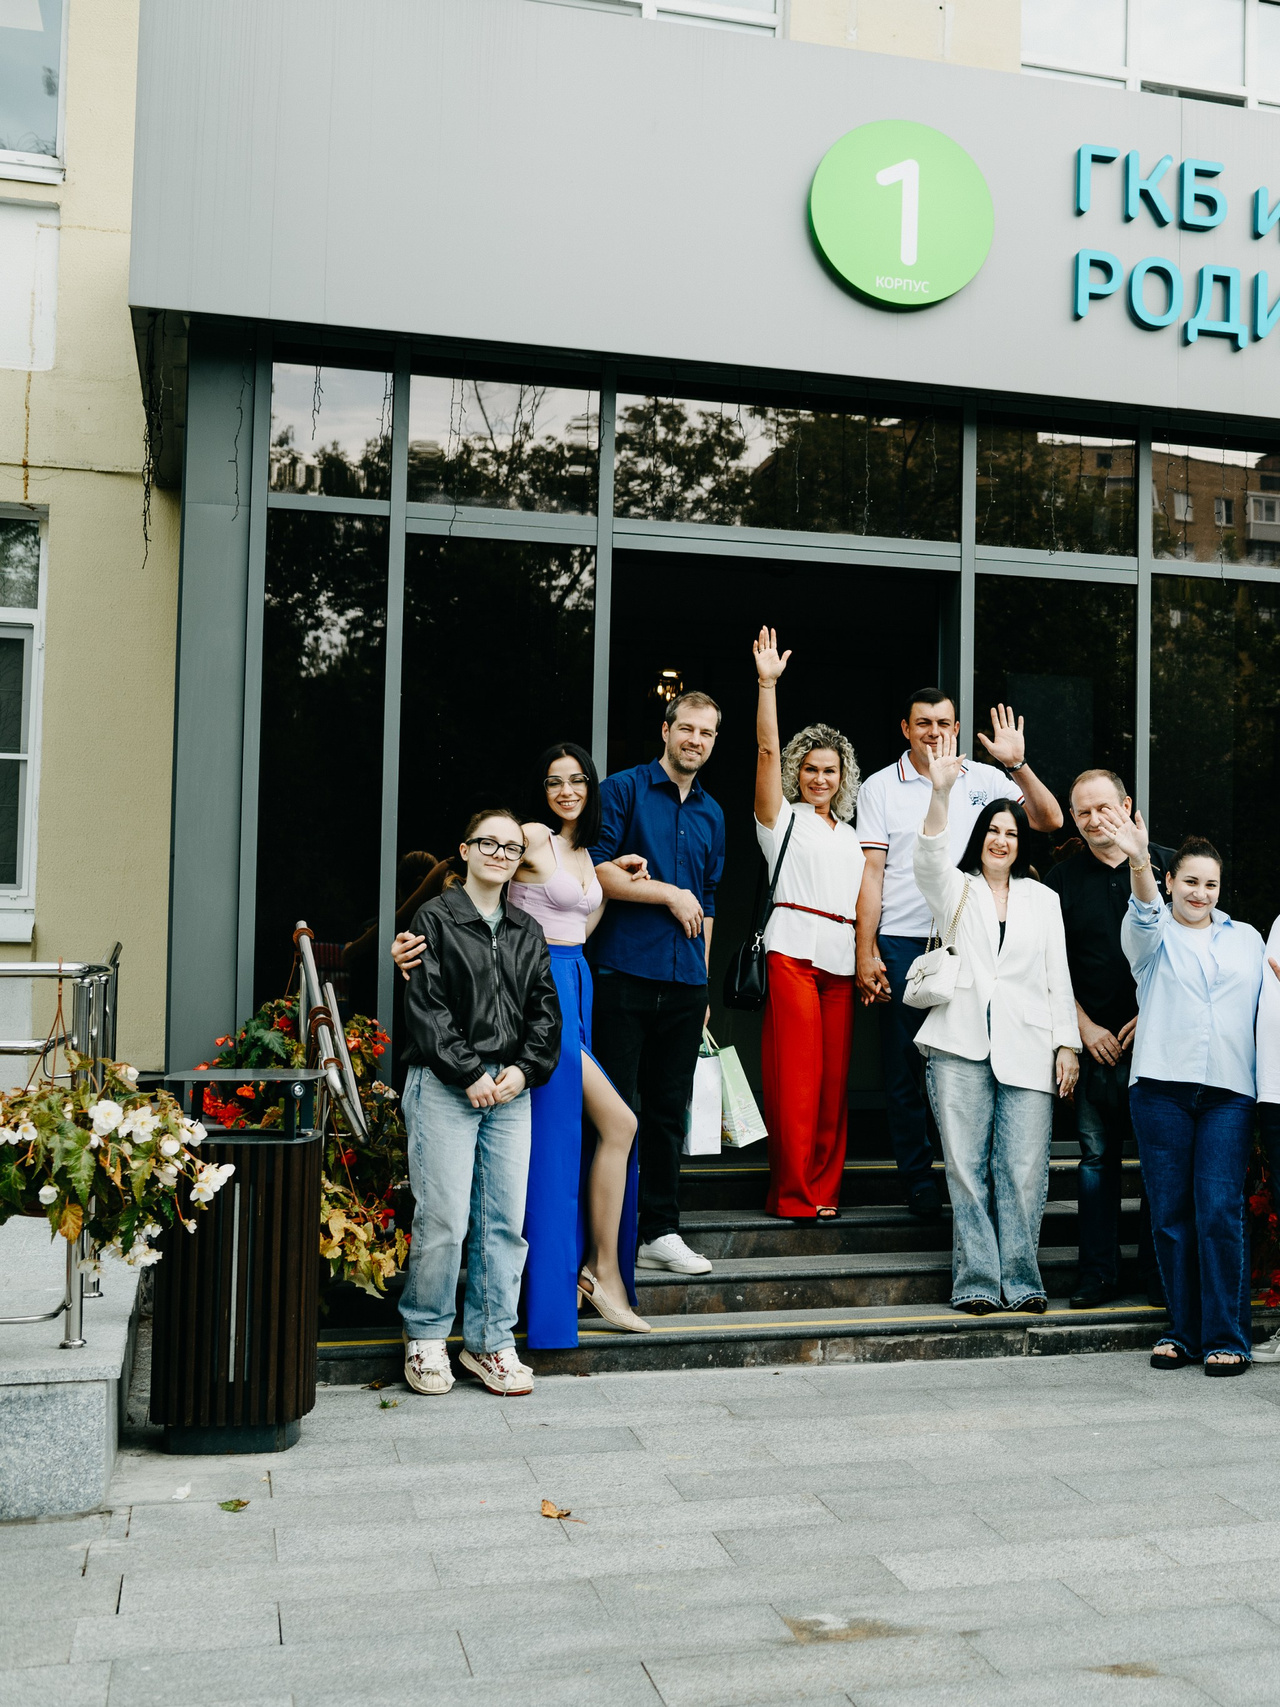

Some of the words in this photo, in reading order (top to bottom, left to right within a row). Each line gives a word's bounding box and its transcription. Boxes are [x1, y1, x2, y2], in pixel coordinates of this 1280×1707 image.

[874, 158, 920, 267] 1
[1074, 143, 1229, 234] ГКБ
[875, 275, 930, 293] КОРПУС
